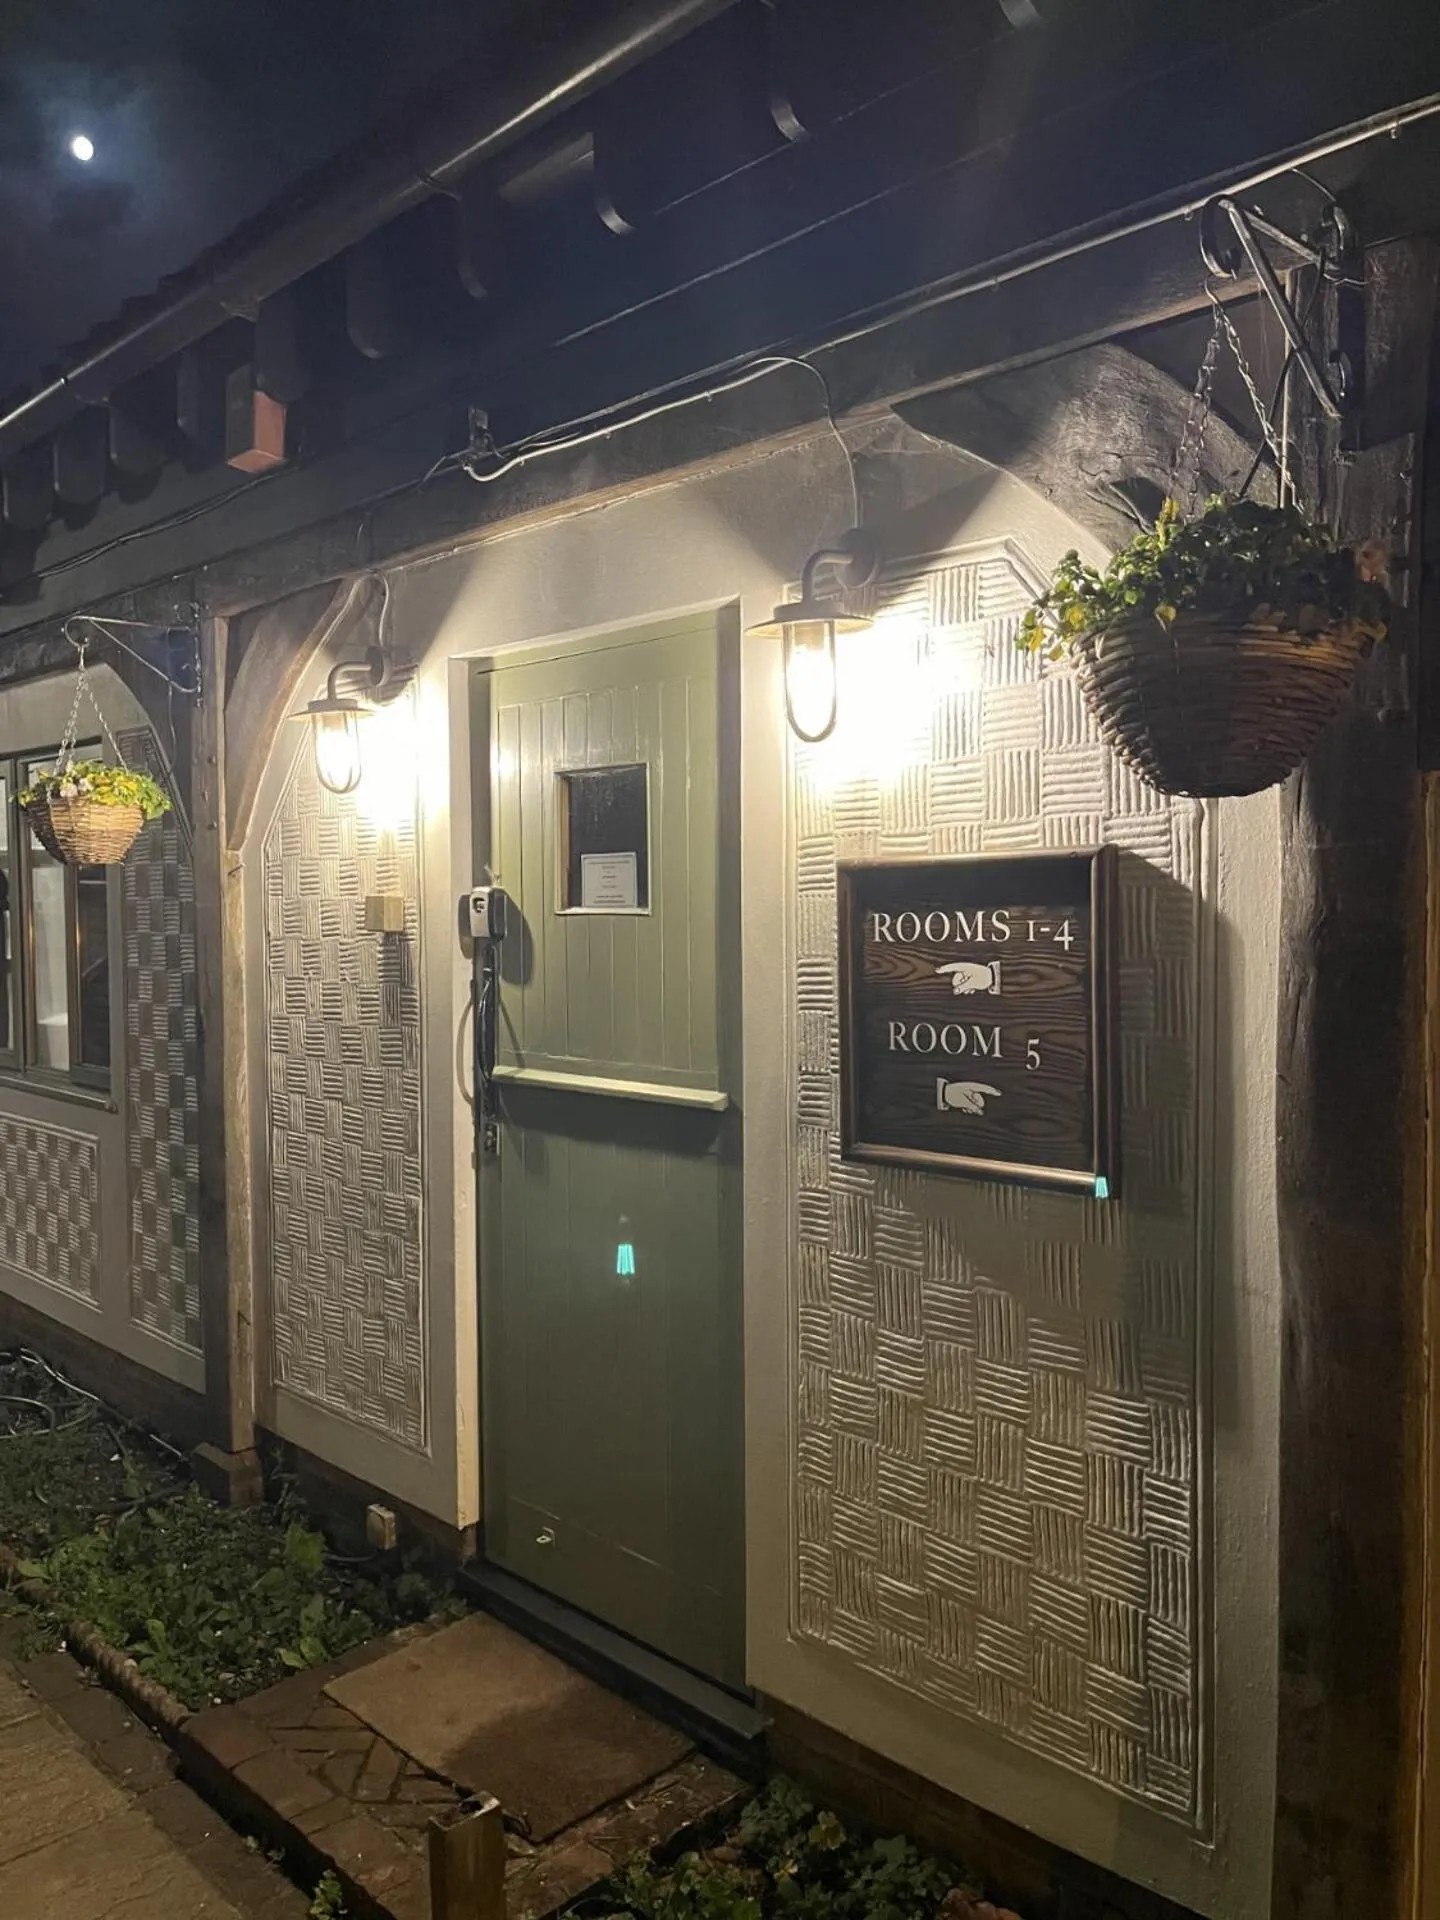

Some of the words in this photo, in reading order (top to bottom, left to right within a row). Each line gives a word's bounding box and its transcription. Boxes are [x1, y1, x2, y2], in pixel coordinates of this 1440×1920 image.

[872, 909, 1011, 943] ROOMS
[888, 1021, 1003, 1058] ROOM
[1025, 1038, 1041, 1071] 5
